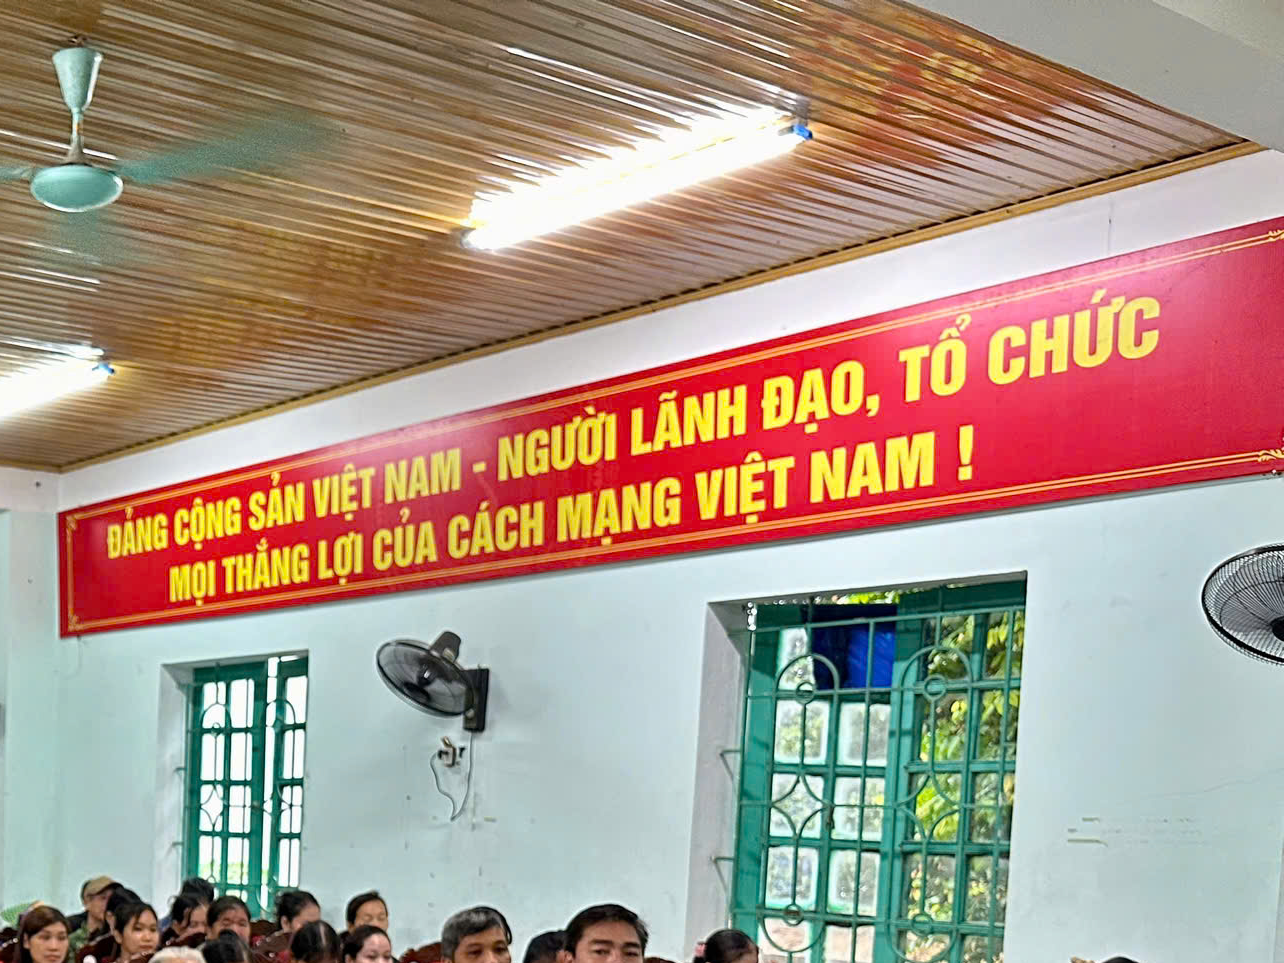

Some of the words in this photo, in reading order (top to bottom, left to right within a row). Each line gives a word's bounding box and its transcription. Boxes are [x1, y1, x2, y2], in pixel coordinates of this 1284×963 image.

[107, 505, 168, 559] ĐẢNG
[174, 497, 242, 550] CỘNG
[248, 471, 305, 531] SẢN
[312, 463, 375, 521] VIỆT
[384, 448, 461, 504] NAM
[497, 406, 617, 481] NGƯỜI
[630, 385, 747, 456] LÃNH
[761, 360, 880, 434] ĐẠO,
[899, 313, 971, 402] TỔ
[987, 288, 1161, 386] CHỨC
[169, 560, 216, 606] MỌI
[222, 537, 310, 594] THẮNG
[318, 531, 364, 586] LỢI
[372, 507, 438, 571] CỦA
[447, 501, 545, 559] CÁCH
[557, 476, 681, 546] MẠNG
[695, 456, 795, 524] VIỆT
[809, 431, 935, 503] NAM
